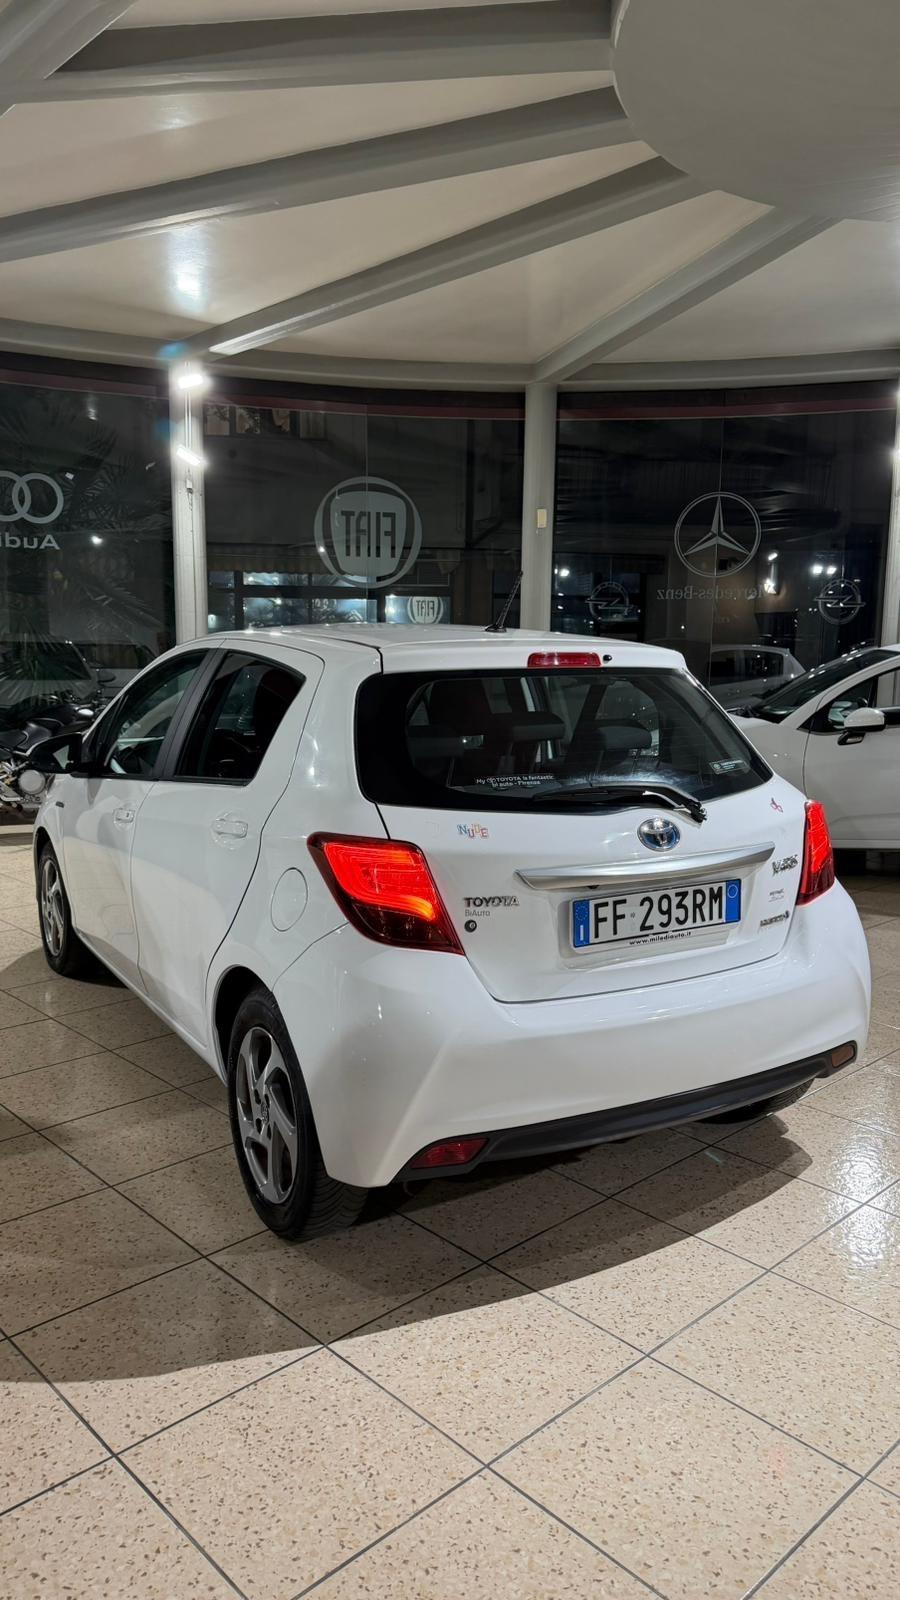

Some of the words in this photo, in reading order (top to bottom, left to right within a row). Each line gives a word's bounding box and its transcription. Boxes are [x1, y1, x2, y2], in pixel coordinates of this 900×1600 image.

[463, 895, 519, 908] TOYOTA
[594, 899, 627, 939] FF
[639, 886, 723, 932] 293RM
[628, 931, 692, 946] www.milediauto.it
